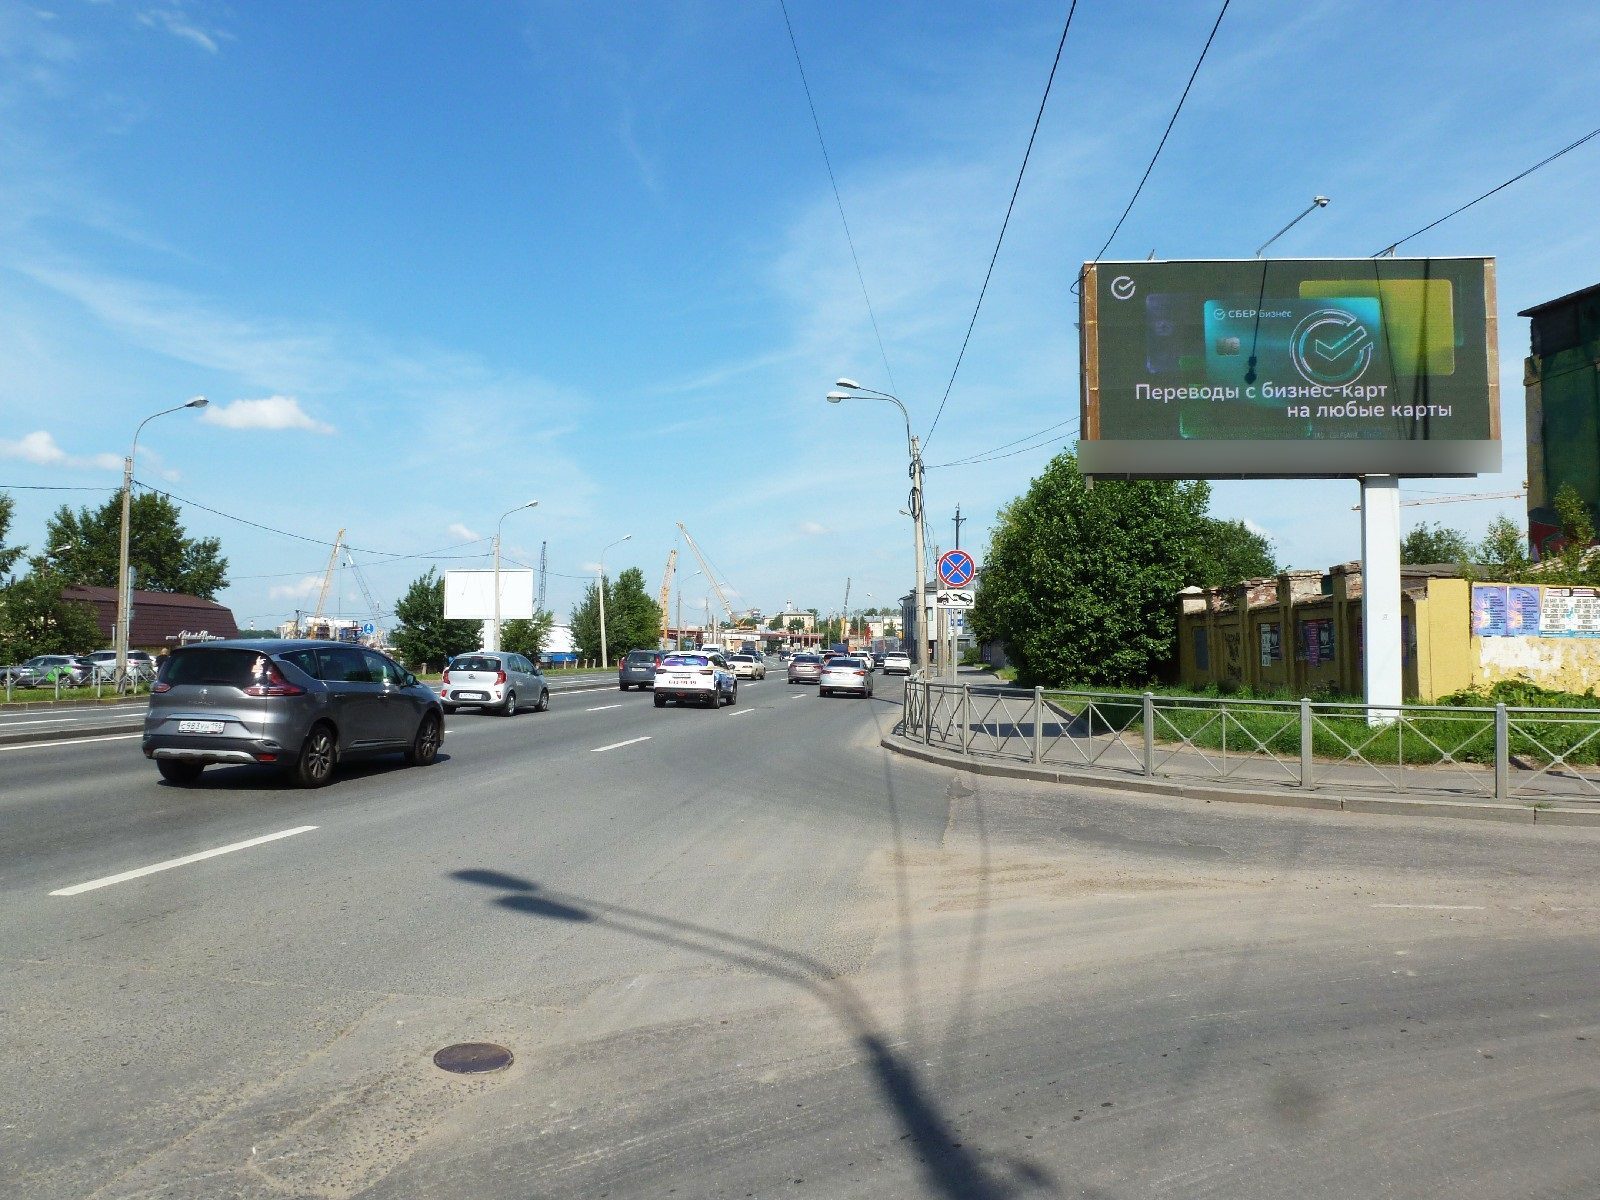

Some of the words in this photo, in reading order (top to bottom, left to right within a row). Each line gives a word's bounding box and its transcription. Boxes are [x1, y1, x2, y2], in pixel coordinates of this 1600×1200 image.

[1228, 309, 1257, 319] СБЕР
[1259, 309, 1292, 319] Бизнес
[1135, 383, 1240, 404] Переводы
[1245, 386, 1256, 399] с
[1261, 381, 1388, 402] бизнес-карт
[1287, 405, 1310, 418] на
[1316, 400, 1385, 418] любые
[1391, 404, 1453, 421] карты
